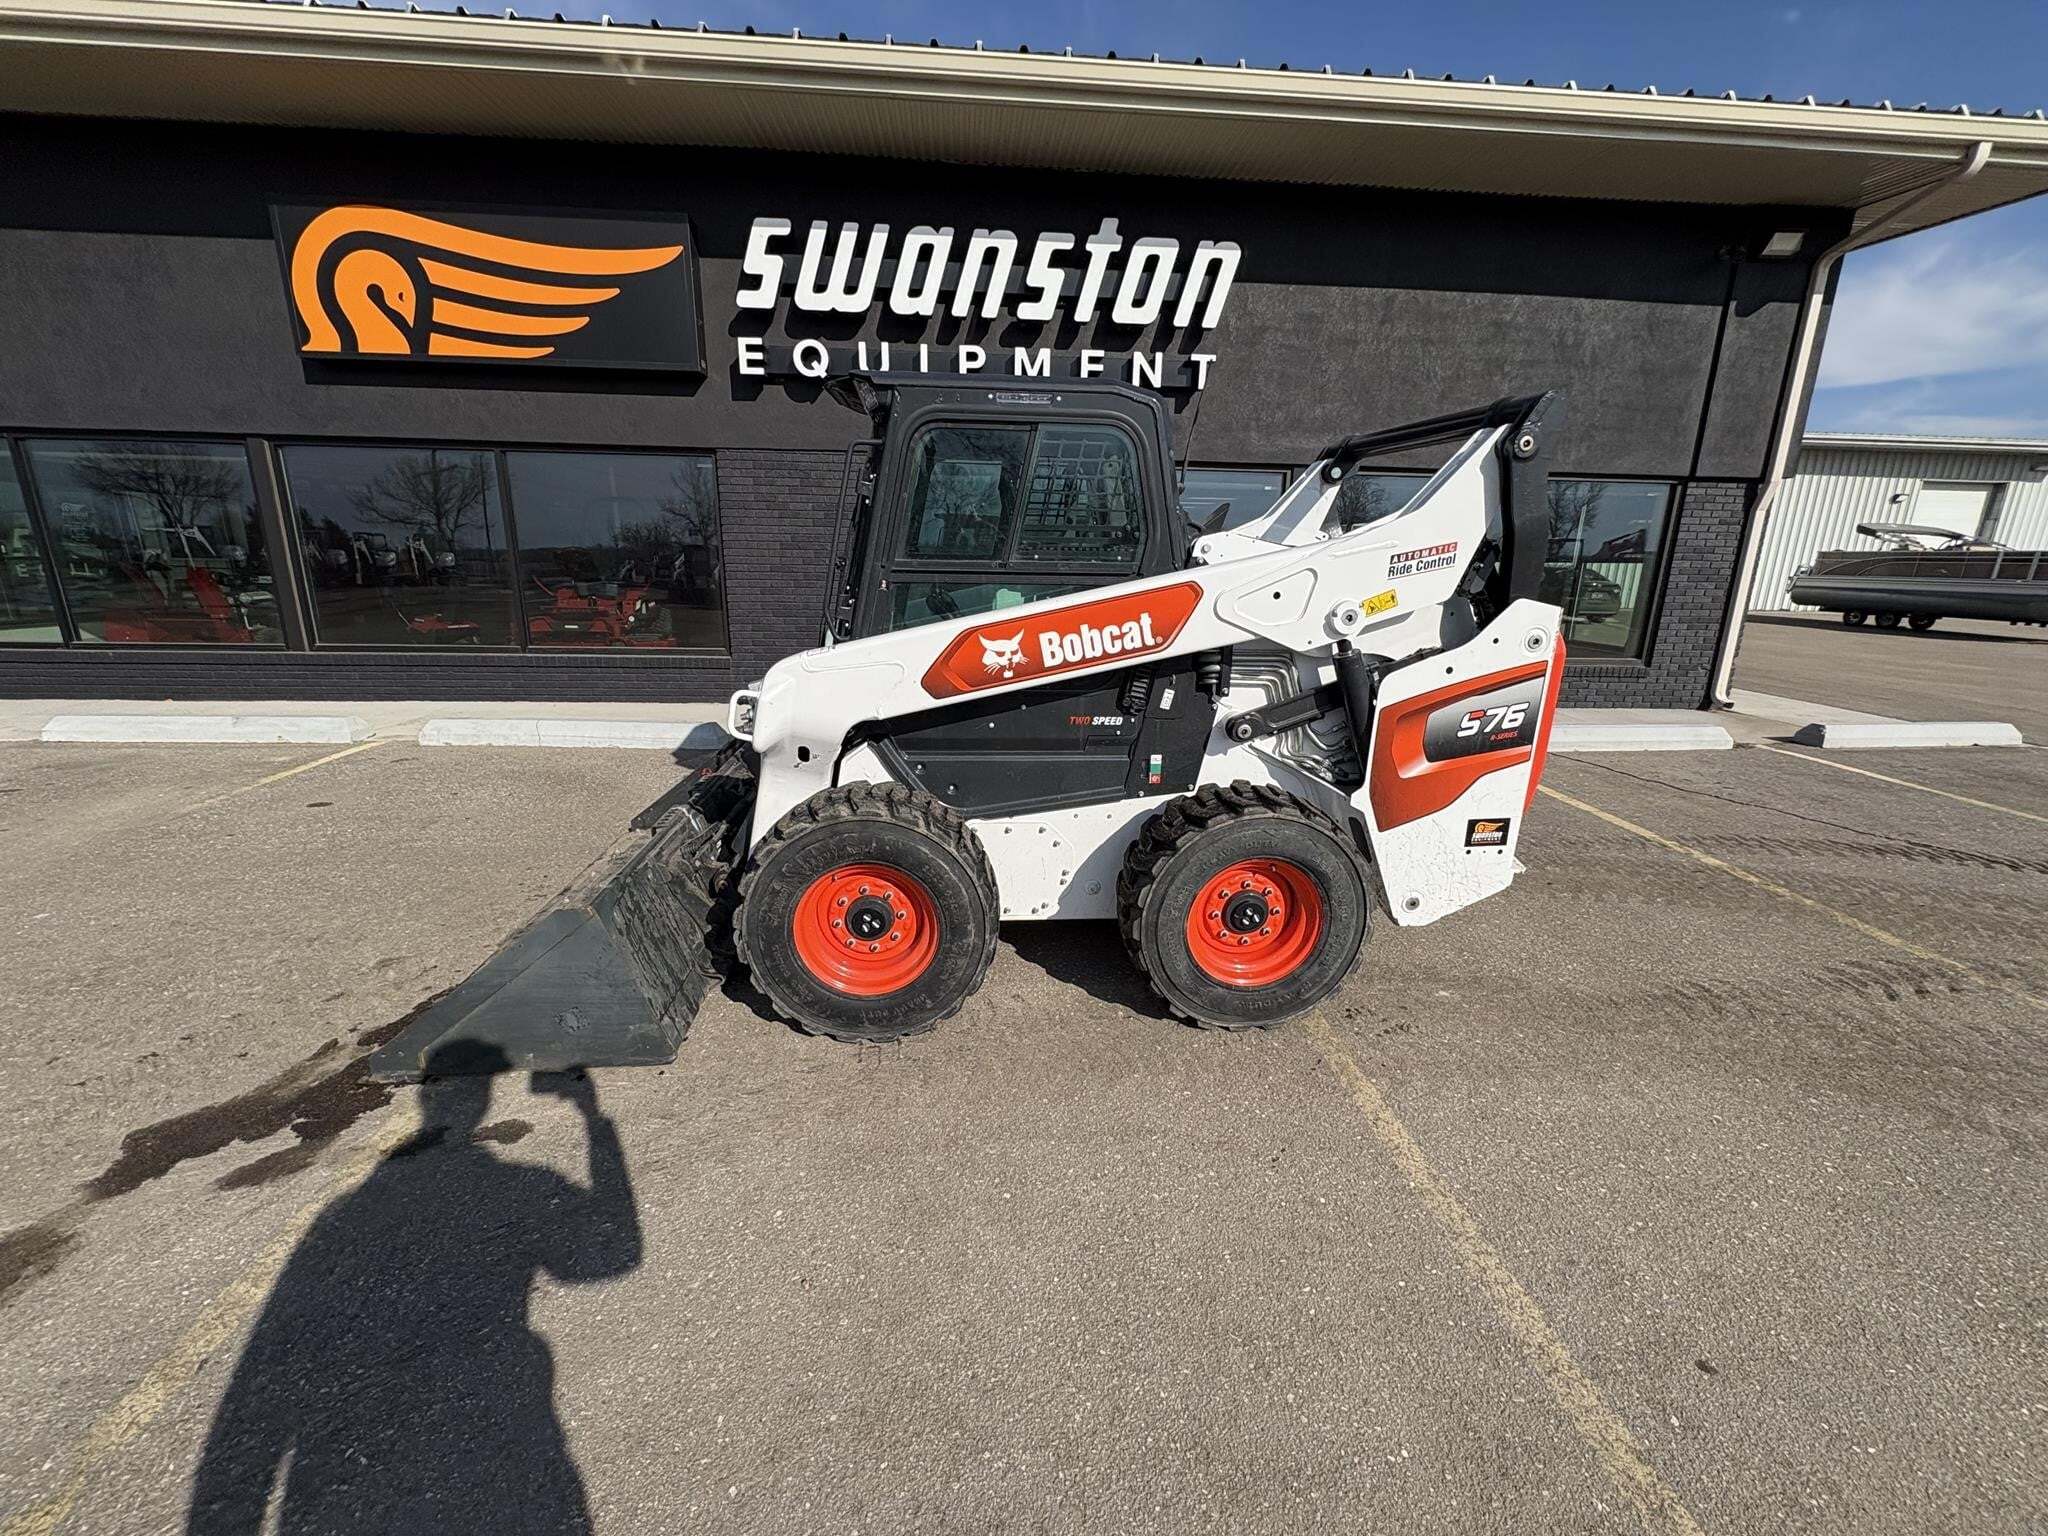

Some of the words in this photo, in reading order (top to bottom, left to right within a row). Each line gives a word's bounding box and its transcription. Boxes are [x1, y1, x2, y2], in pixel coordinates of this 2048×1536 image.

[737, 337, 1217, 391] EQUIPMENT
[1388, 563, 1413, 578] Ride
[1416, 553, 1457, 572] Control
[1391, 543, 1457, 564] AUTOMATIC
[1039, 612, 1156, 668] Bobcat
[1070, 715, 1091, 725] TWO
[1091, 716, 1123, 726] SPEED
[1457, 701, 1531, 738] S76
